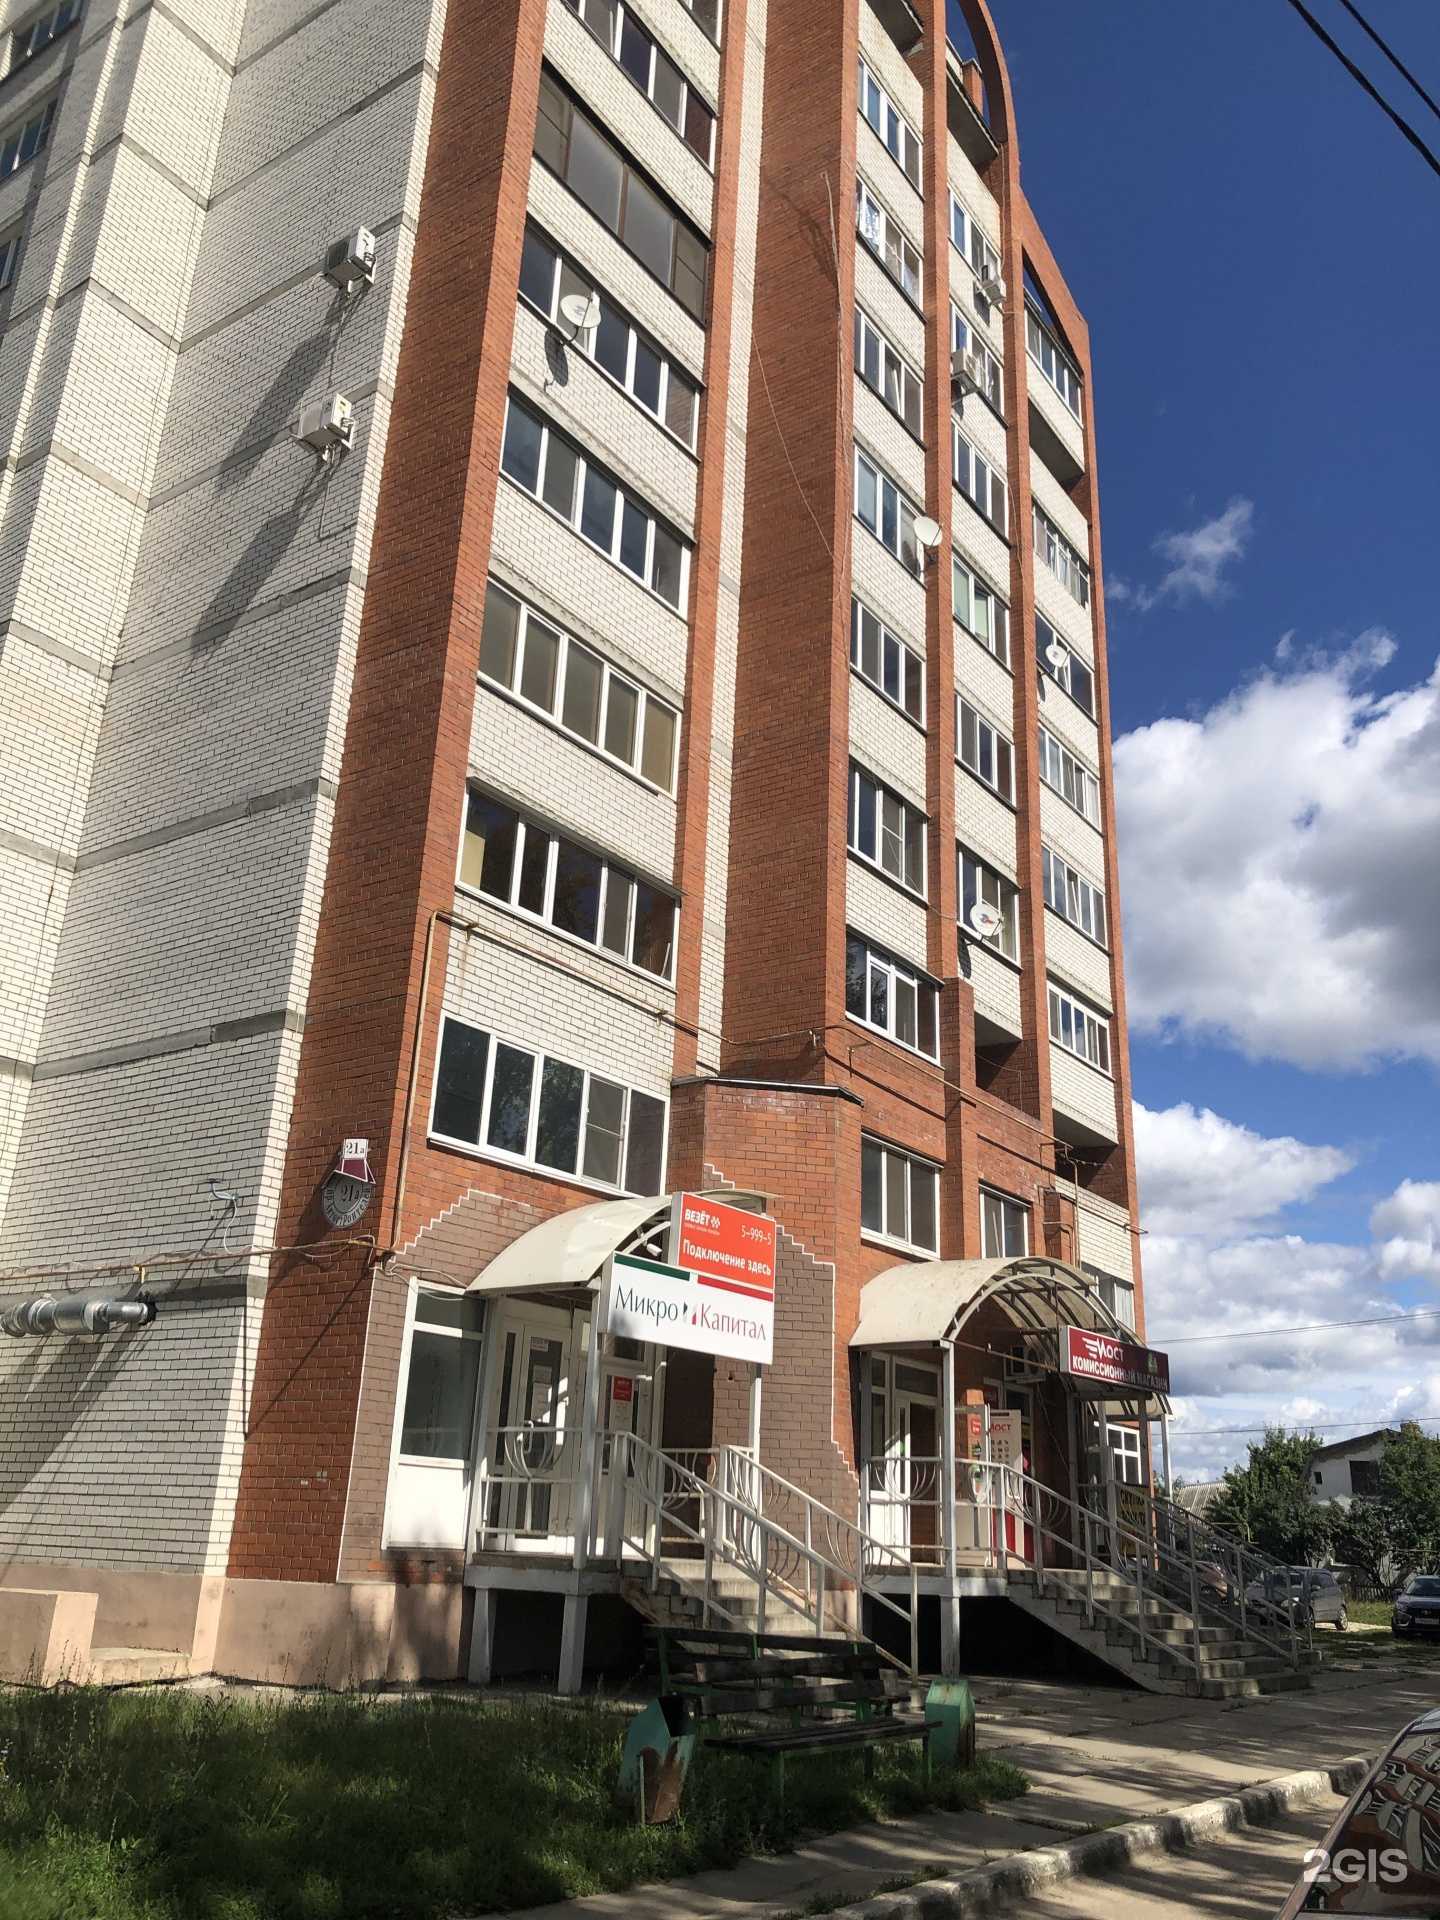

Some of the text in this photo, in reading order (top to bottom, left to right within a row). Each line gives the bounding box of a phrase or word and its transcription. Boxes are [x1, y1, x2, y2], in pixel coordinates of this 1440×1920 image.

[684, 1208, 711, 1227] ВЕЗЁТ
[741, 1224, 772, 1246] 5-999-5
[682, 1238, 772, 1277] Подключение здесь
[615, 1285, 767, 1341] Микро Капитал
[1072, 1355, 1136, 1385] КОМИССИОННЫЙ
